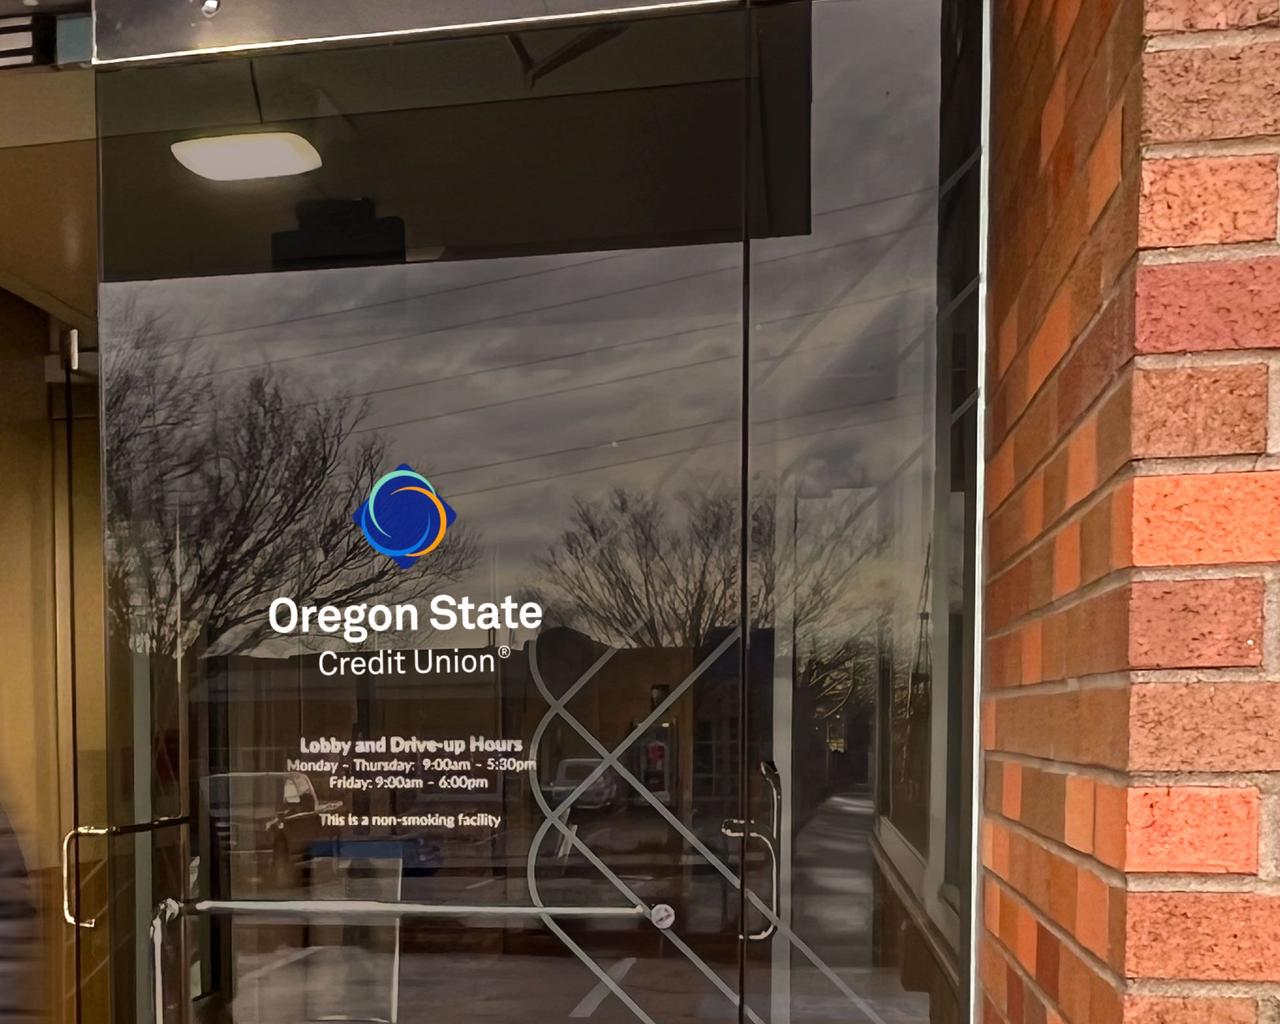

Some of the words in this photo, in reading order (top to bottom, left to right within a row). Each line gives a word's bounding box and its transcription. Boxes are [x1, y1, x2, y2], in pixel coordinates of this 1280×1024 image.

[268, 597, 418, 643] Oregon
[429, 594, 543, 631] State
[318, 649, 406, 676] Credit
[300, 736, 351, 756] Lobby
[354, 737, 387, 753] and
[390, 736, 466, 756] Drive-up
[469, 735, 524, 752] Hours
[287, 759, 339, 773] Monday
[353, 759, 416, 774] Thursday:
[422, 758, 472, 771] 9:00am
[486, 758, 537, 773] 5:30pm
[329, 775, 373, 791] Friday:
[375, 776, 424, 789] 9:00am
[438, 775, 489, 791] 6:00pm
[319, 813, 345, 827] This
[347, 813, 359, 826] is
[360, 815, 369, 826] a
[371, 813, 455, 828] non-smoking
[458, 813, 502, 828] facility
